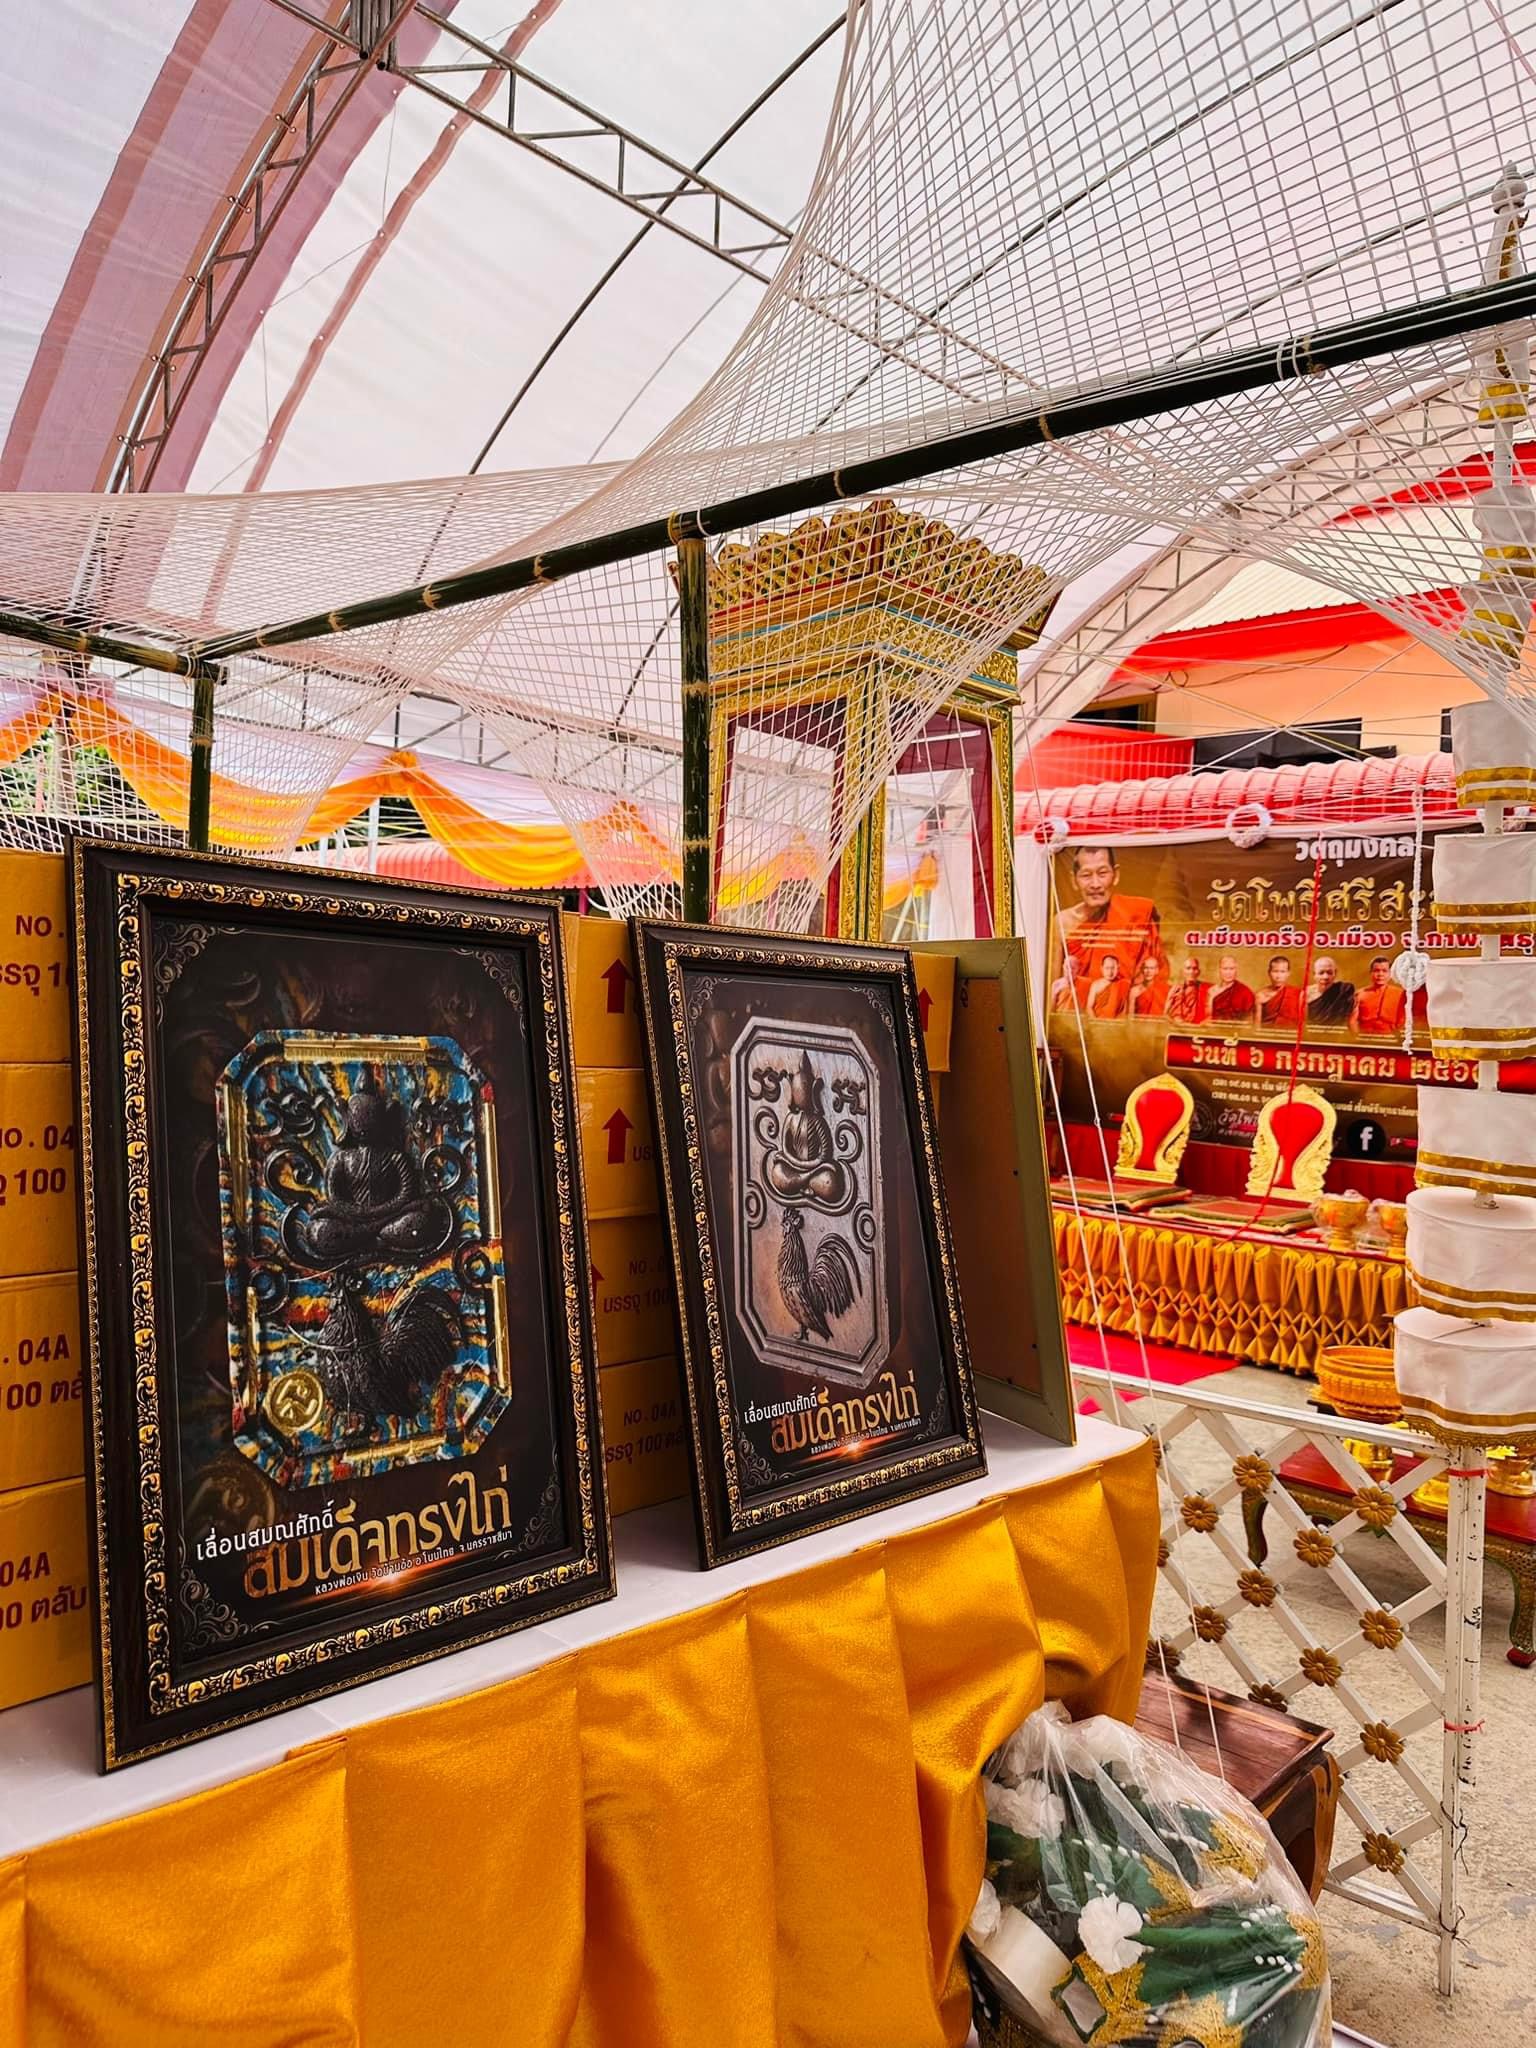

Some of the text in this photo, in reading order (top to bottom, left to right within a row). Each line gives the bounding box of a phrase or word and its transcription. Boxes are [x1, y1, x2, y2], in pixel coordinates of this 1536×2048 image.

[1185, 926, 1308, 948] ต.เชียงเครือ
[1316, 925, 1395, 948] อ.เมือง
[1191, 1032, 1239, 1066] วันที่
[1360, 1126, 1374, 1151] f
[14, 1168, 67, 1196] 100
[18, 1334, 70, 1364] 04A
[196, 1499, 335, 1561] เลื่อนสมณศักดิ์
[244, 1464, 514, 1599] สมเด็จทรงไก่
[31, 1585, 87, 1621] ตลับ
